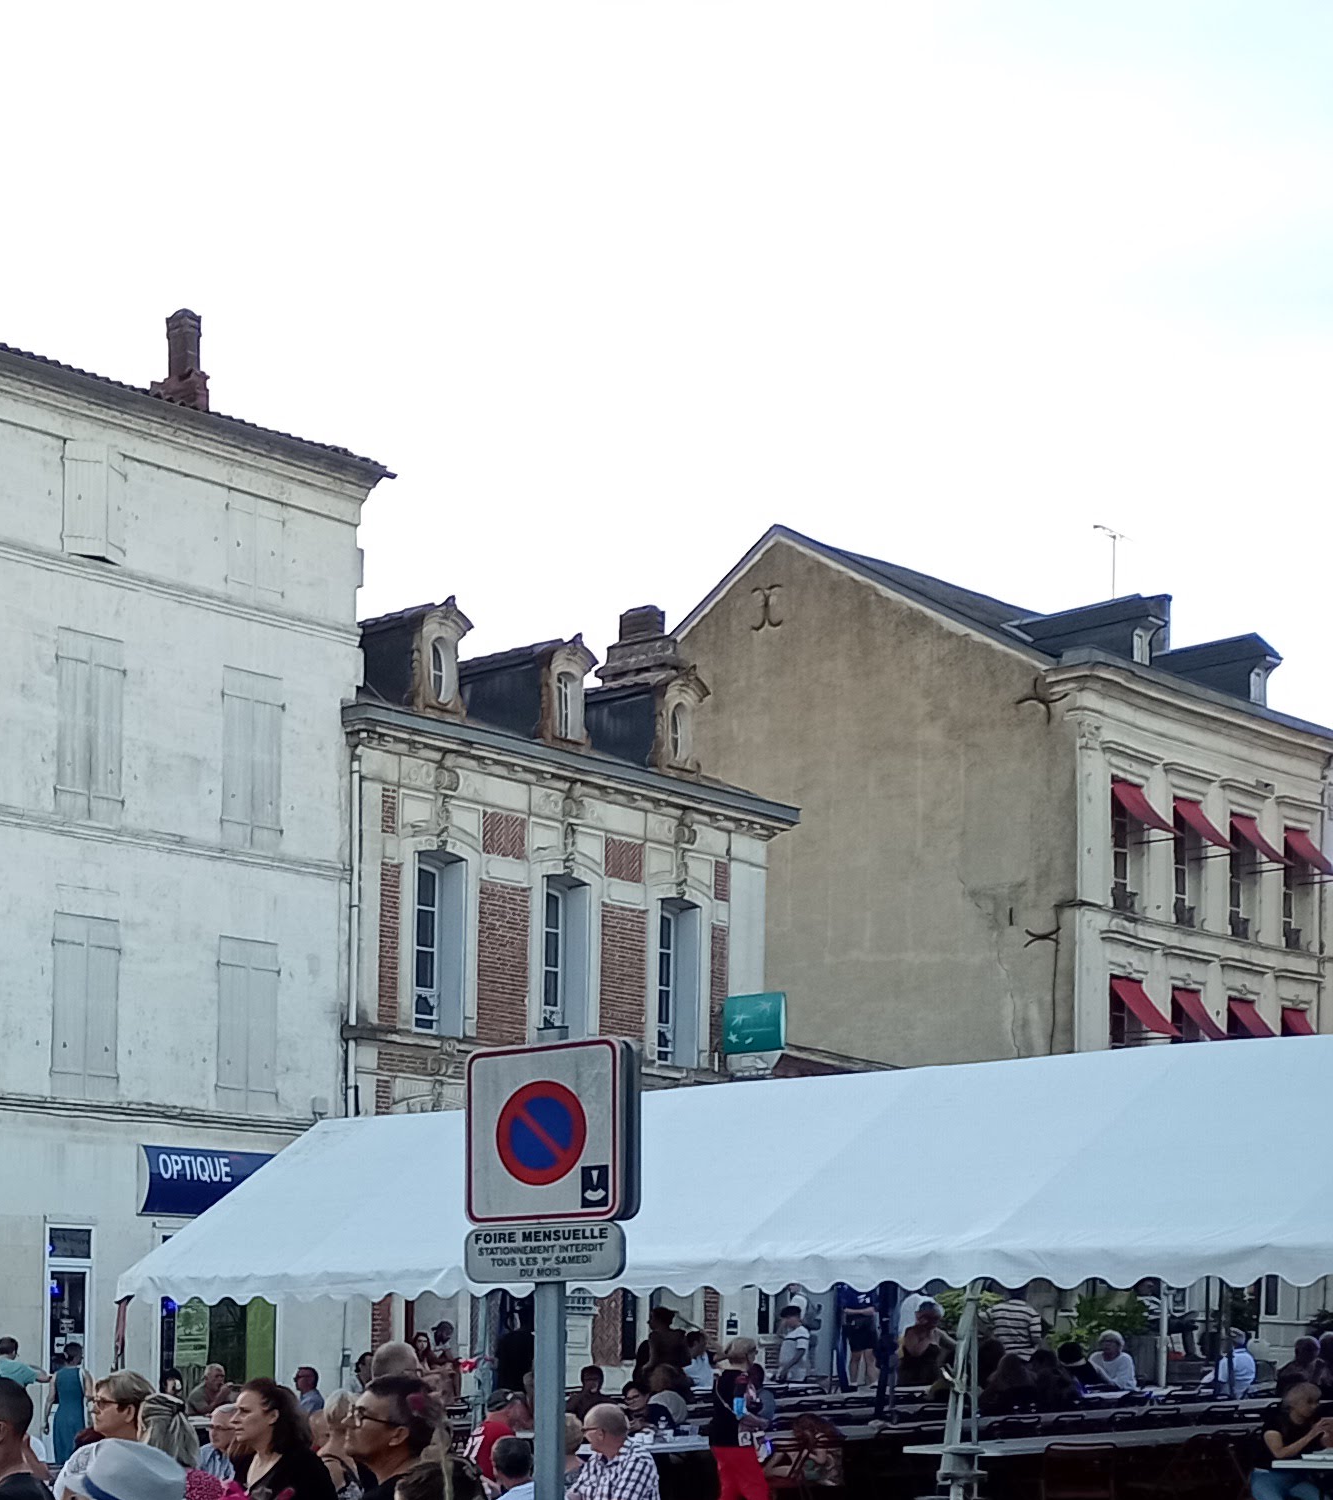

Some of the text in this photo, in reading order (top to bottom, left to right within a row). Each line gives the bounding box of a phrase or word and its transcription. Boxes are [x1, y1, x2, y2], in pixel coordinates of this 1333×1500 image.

[158, 1153, 232, 1183] OPTIQUE
[474, 1227, 609, 1245] FOIRE MENSUELLE
[477, 1242, 605, 1257] STATIONNEMENT INTERDIT
[490, 1257, 518, 1267] TOUS
[519, 1256, 539, 1267] LES
[555, 1254, 592, 1266] SAMEDI
[519, 1267, 562, 1278] DU MOIS
